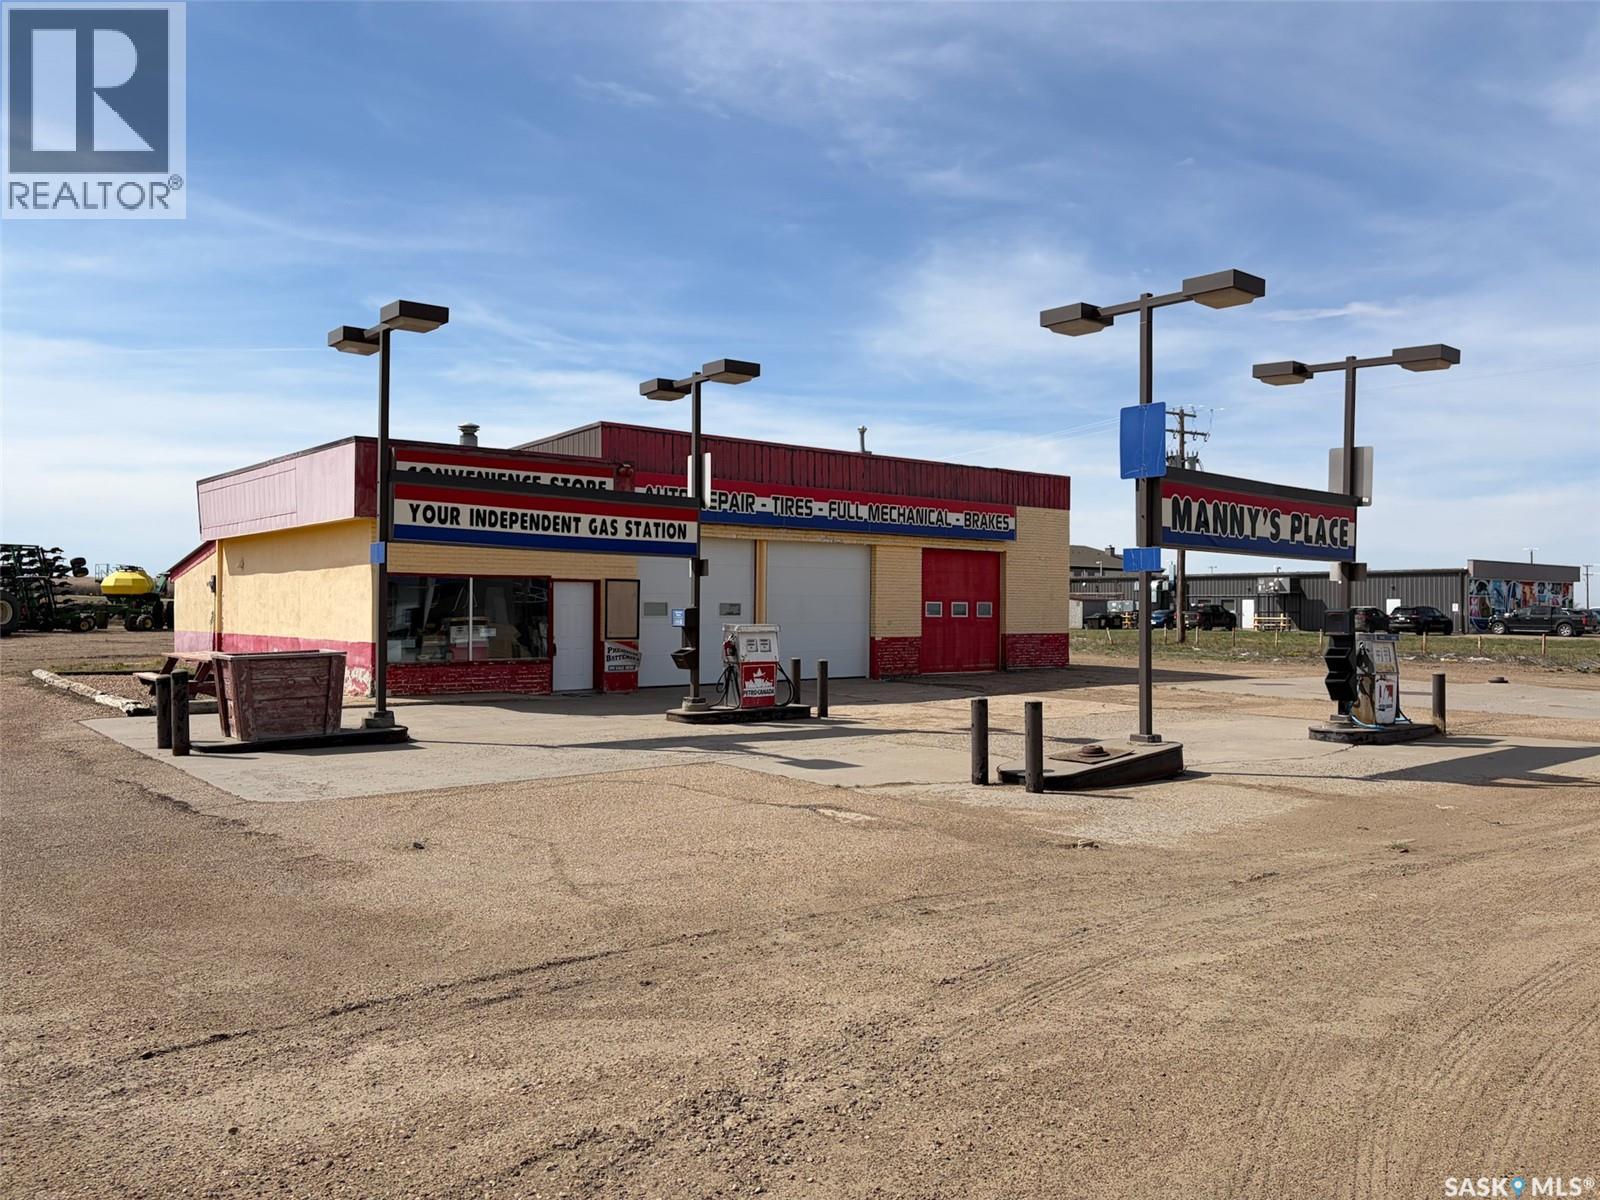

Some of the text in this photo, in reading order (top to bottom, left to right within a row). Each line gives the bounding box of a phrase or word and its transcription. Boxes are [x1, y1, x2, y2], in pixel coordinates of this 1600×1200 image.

[409, 503, 687, 540] YOUR INDEPENDENT GAS STATION
[772, 495, 813, 517] TIRES
[828, 500, 864, 521] FULL
[867, 504, 952, 527] MECHANICAL
[963, 511, 1010, 531] BRAKES
[1171, 495, 1349, 547] MANNY'S PLACE
